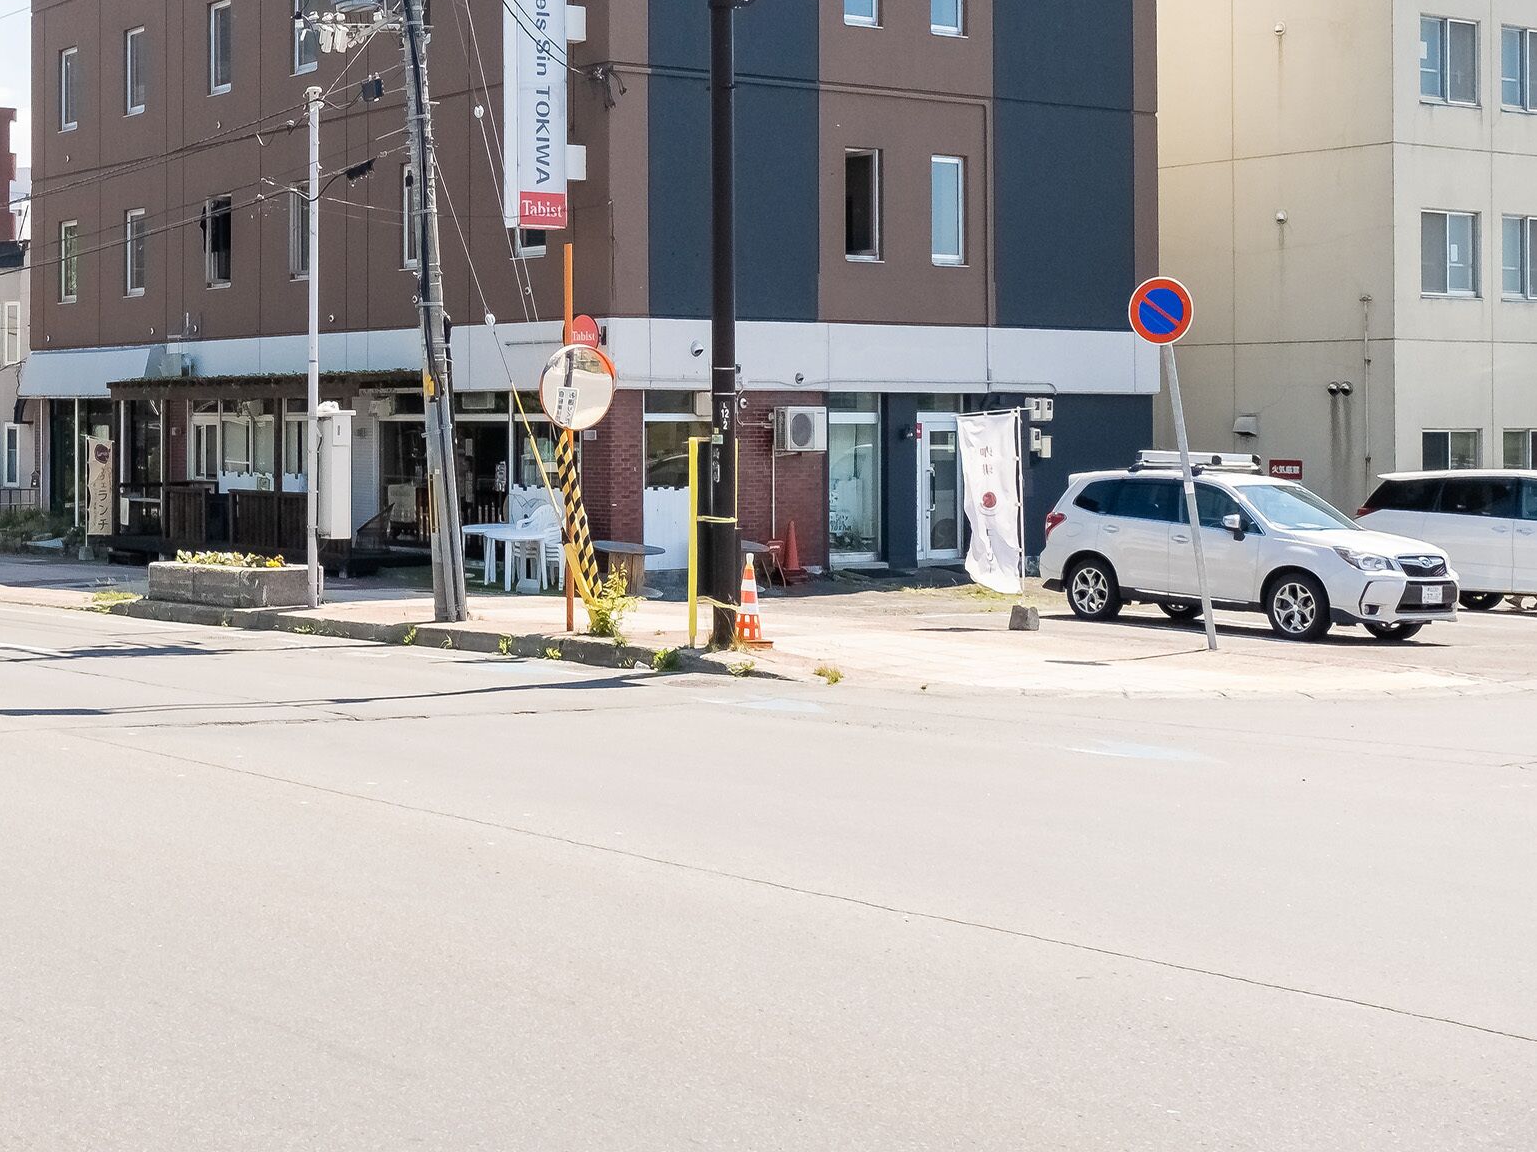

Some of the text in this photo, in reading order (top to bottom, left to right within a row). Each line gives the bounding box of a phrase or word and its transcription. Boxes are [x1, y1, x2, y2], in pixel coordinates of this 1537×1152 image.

[535, 85, 551, 184] TOKIWA
[521, 199, 563, 218] Tabist
[572, 330, 595, 341] Tabist
[721, 408, 730, 418] 12
